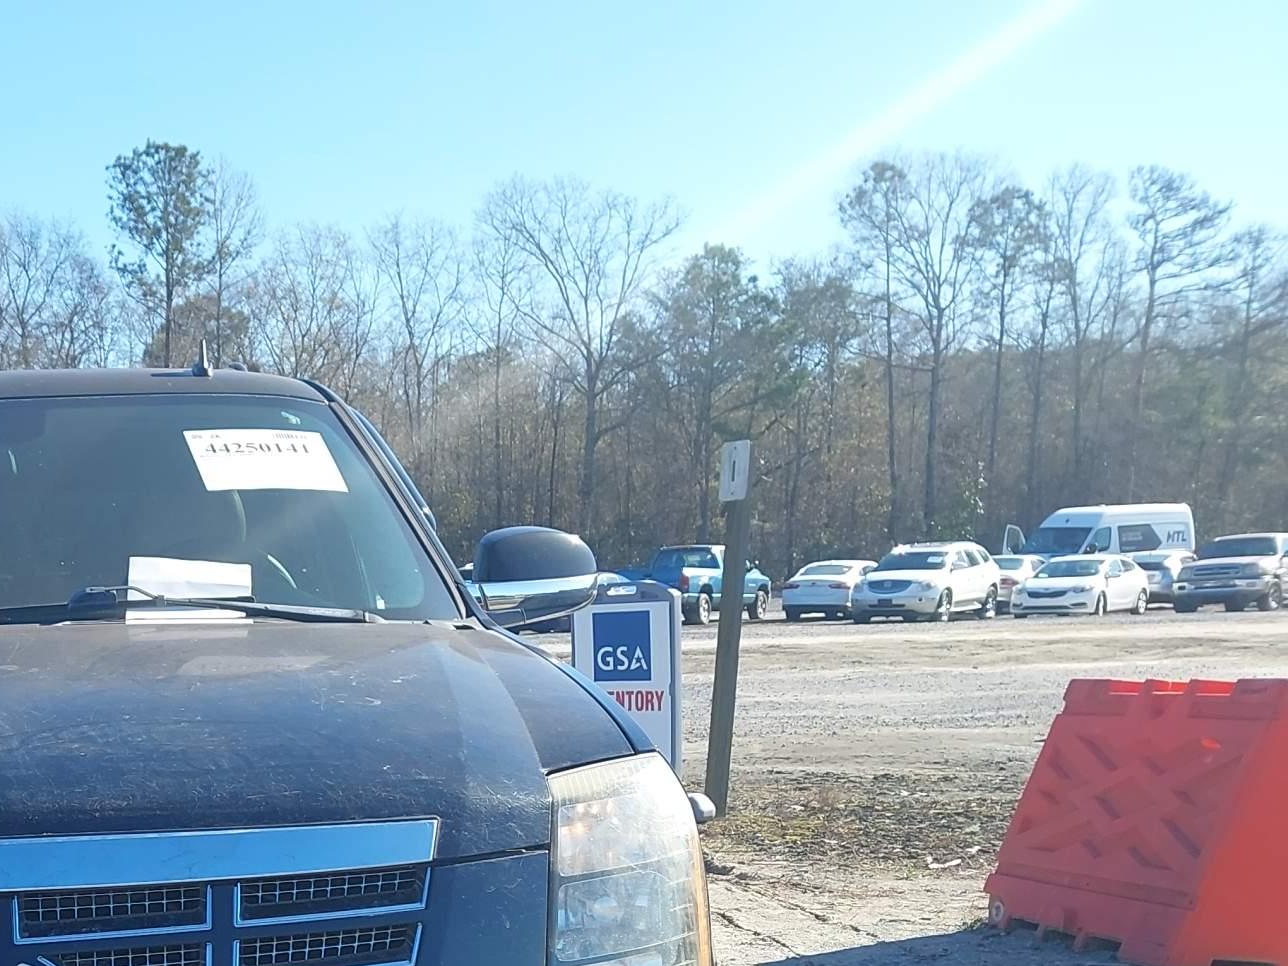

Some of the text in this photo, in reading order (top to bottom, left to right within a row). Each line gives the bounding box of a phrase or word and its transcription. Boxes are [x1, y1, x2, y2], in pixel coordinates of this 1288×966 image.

[205, 442, 309, 454] 44250141
[597, 645, 648, 671] GSA
[608, 690, 665, 711] NTORY
